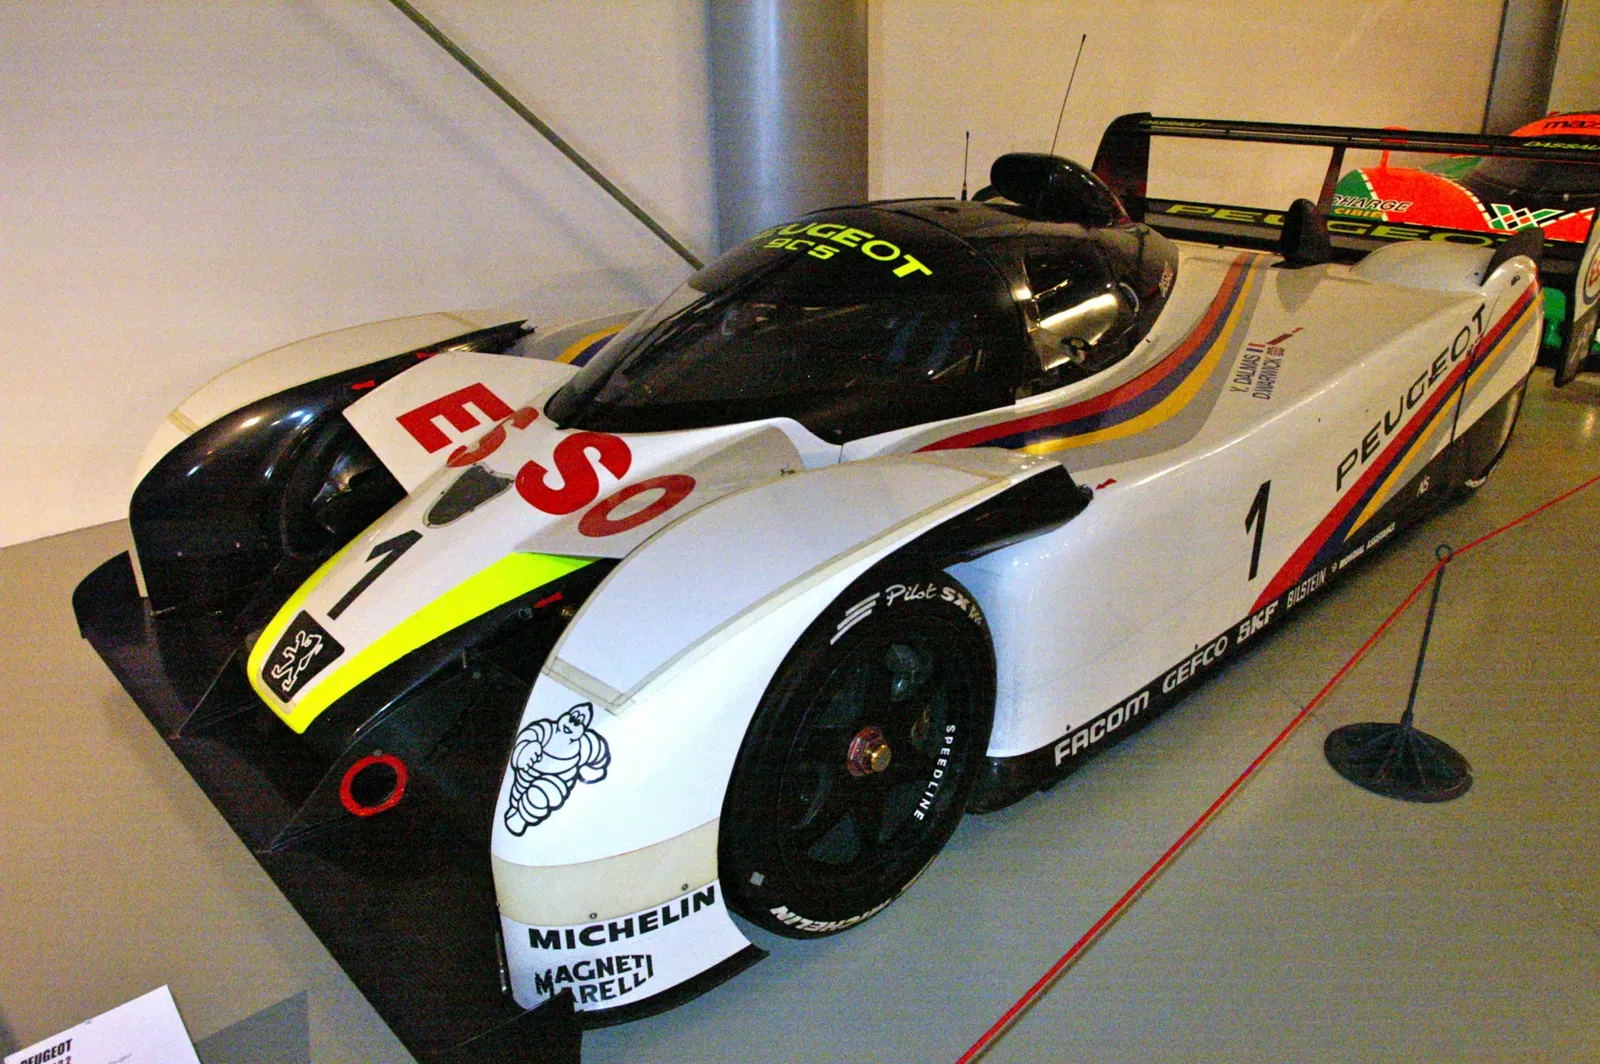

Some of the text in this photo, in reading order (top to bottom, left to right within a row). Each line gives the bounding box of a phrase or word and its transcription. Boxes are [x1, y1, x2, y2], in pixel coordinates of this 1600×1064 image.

[1336, 303, 1485, 492] PEUGEOT
[327, 529, 423, 621] 1
[1244, 479, 1272, 582] 1
[885, 583, 938, 607] Pilot
[1054, 689, 1150, 767] FACOM
[1161, 635, 1229, 695] GEFCO
[1236, 600, 1279, 645] SKF
[1286, 566, 1328, 610] BILSTEIN
[913, 724, 957, 822] SPEEDLINE
[528, 885, 716, 951] MICHELIN
[534, 953, 655, 999] MAGNETI
